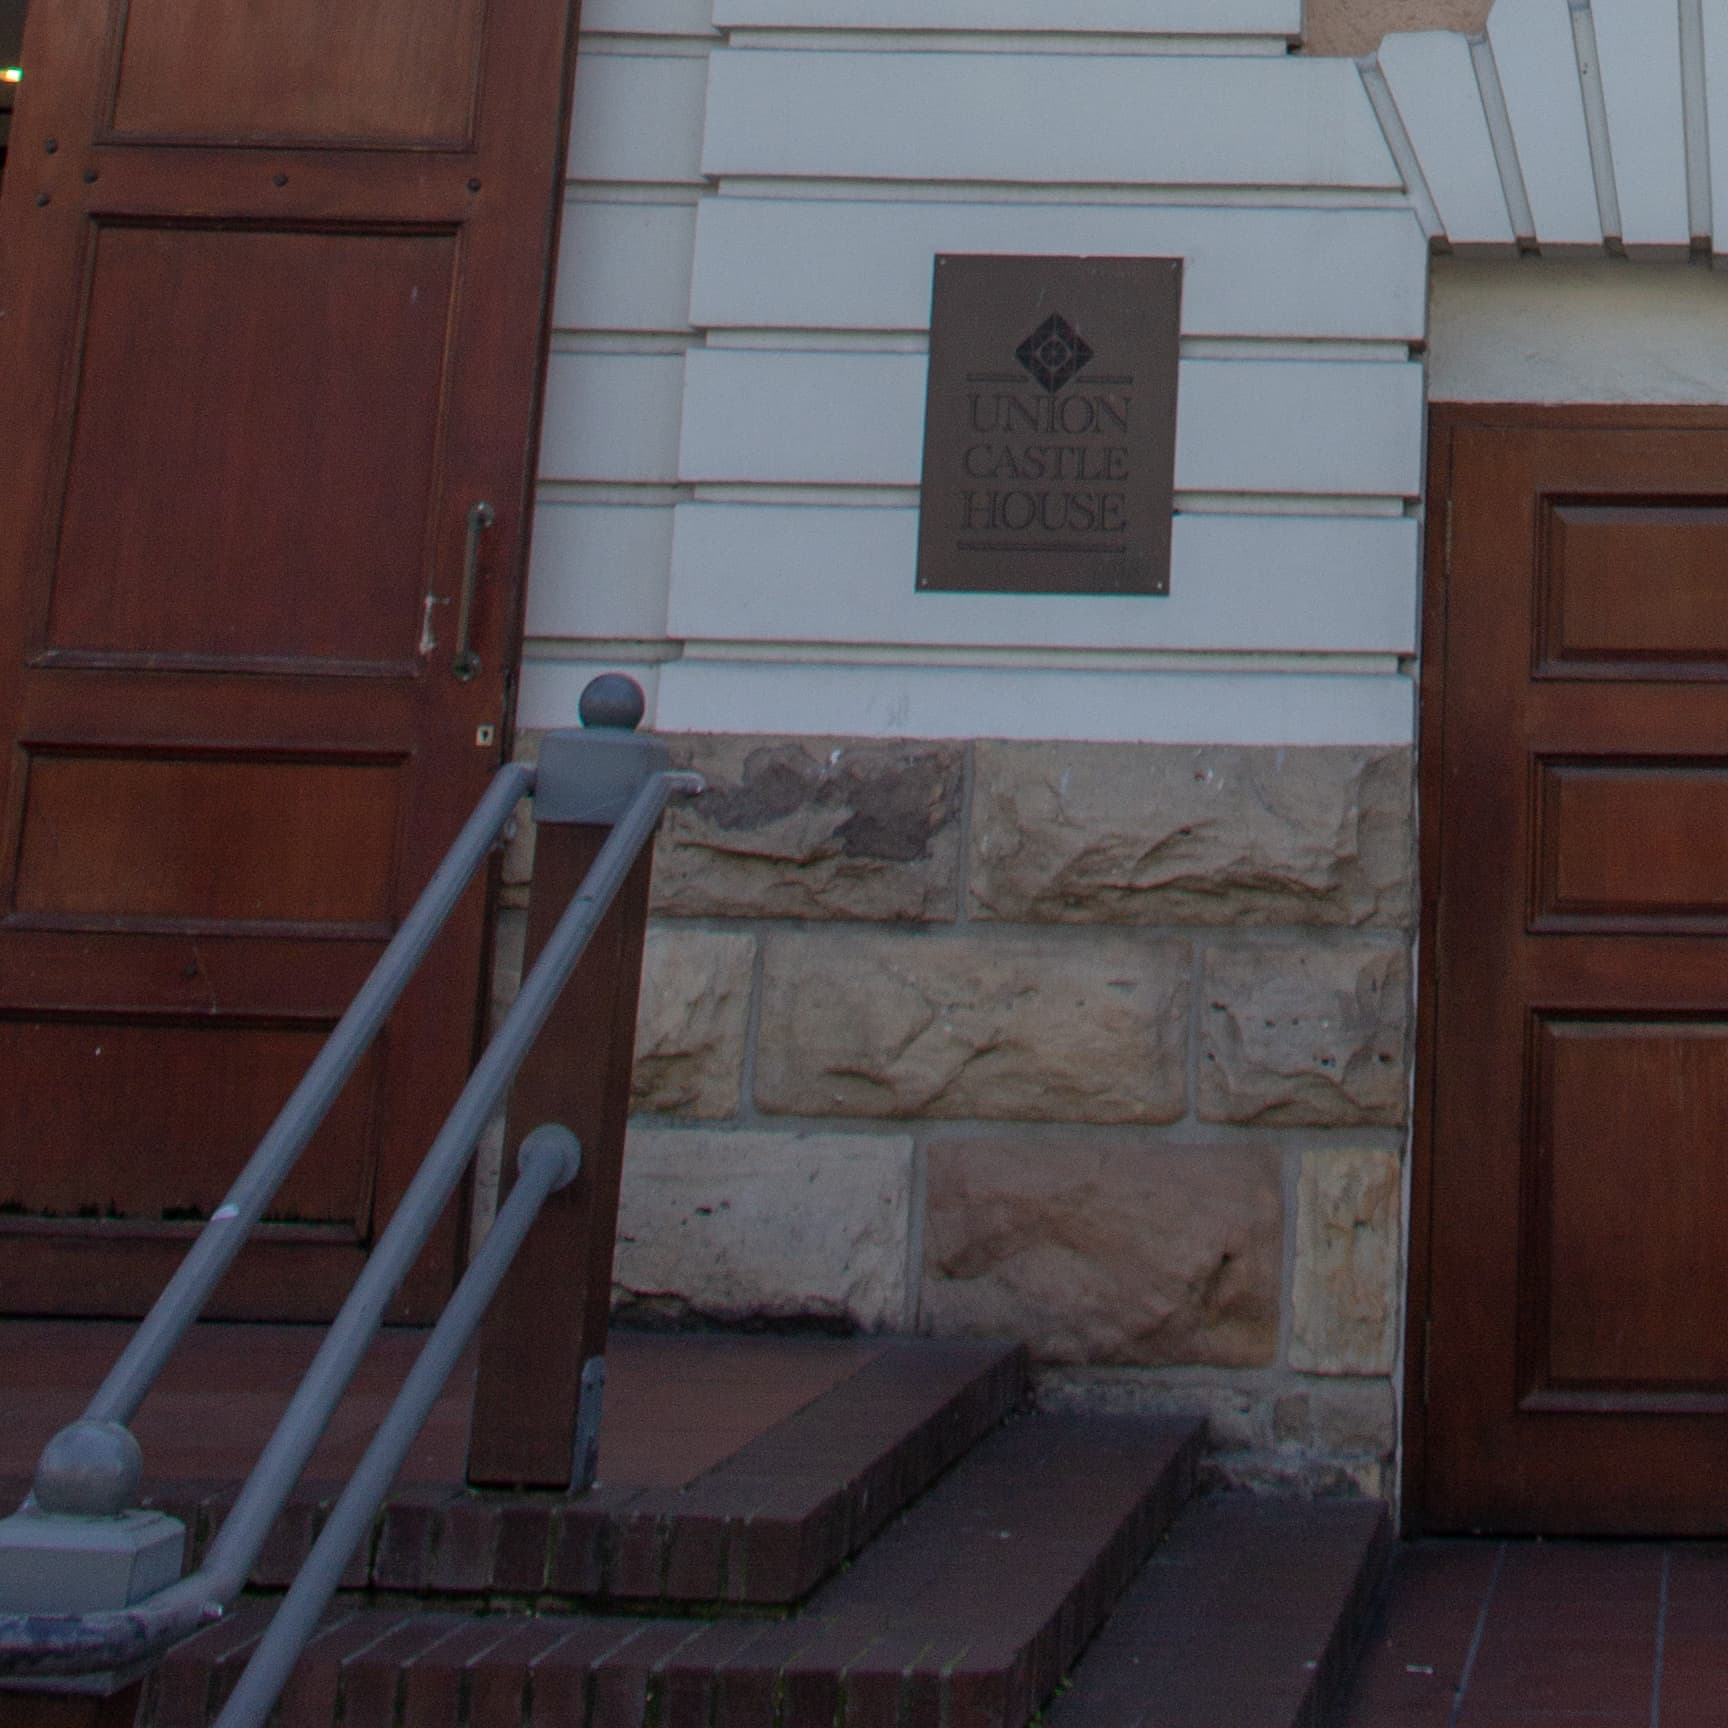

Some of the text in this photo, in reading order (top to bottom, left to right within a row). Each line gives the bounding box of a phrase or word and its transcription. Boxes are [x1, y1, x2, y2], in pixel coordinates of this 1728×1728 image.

[966, 394, 1132, 435] UNION
[962, 443, 1130, 481] CASTLE
[959, 490, 1127, 532] HOUSE
